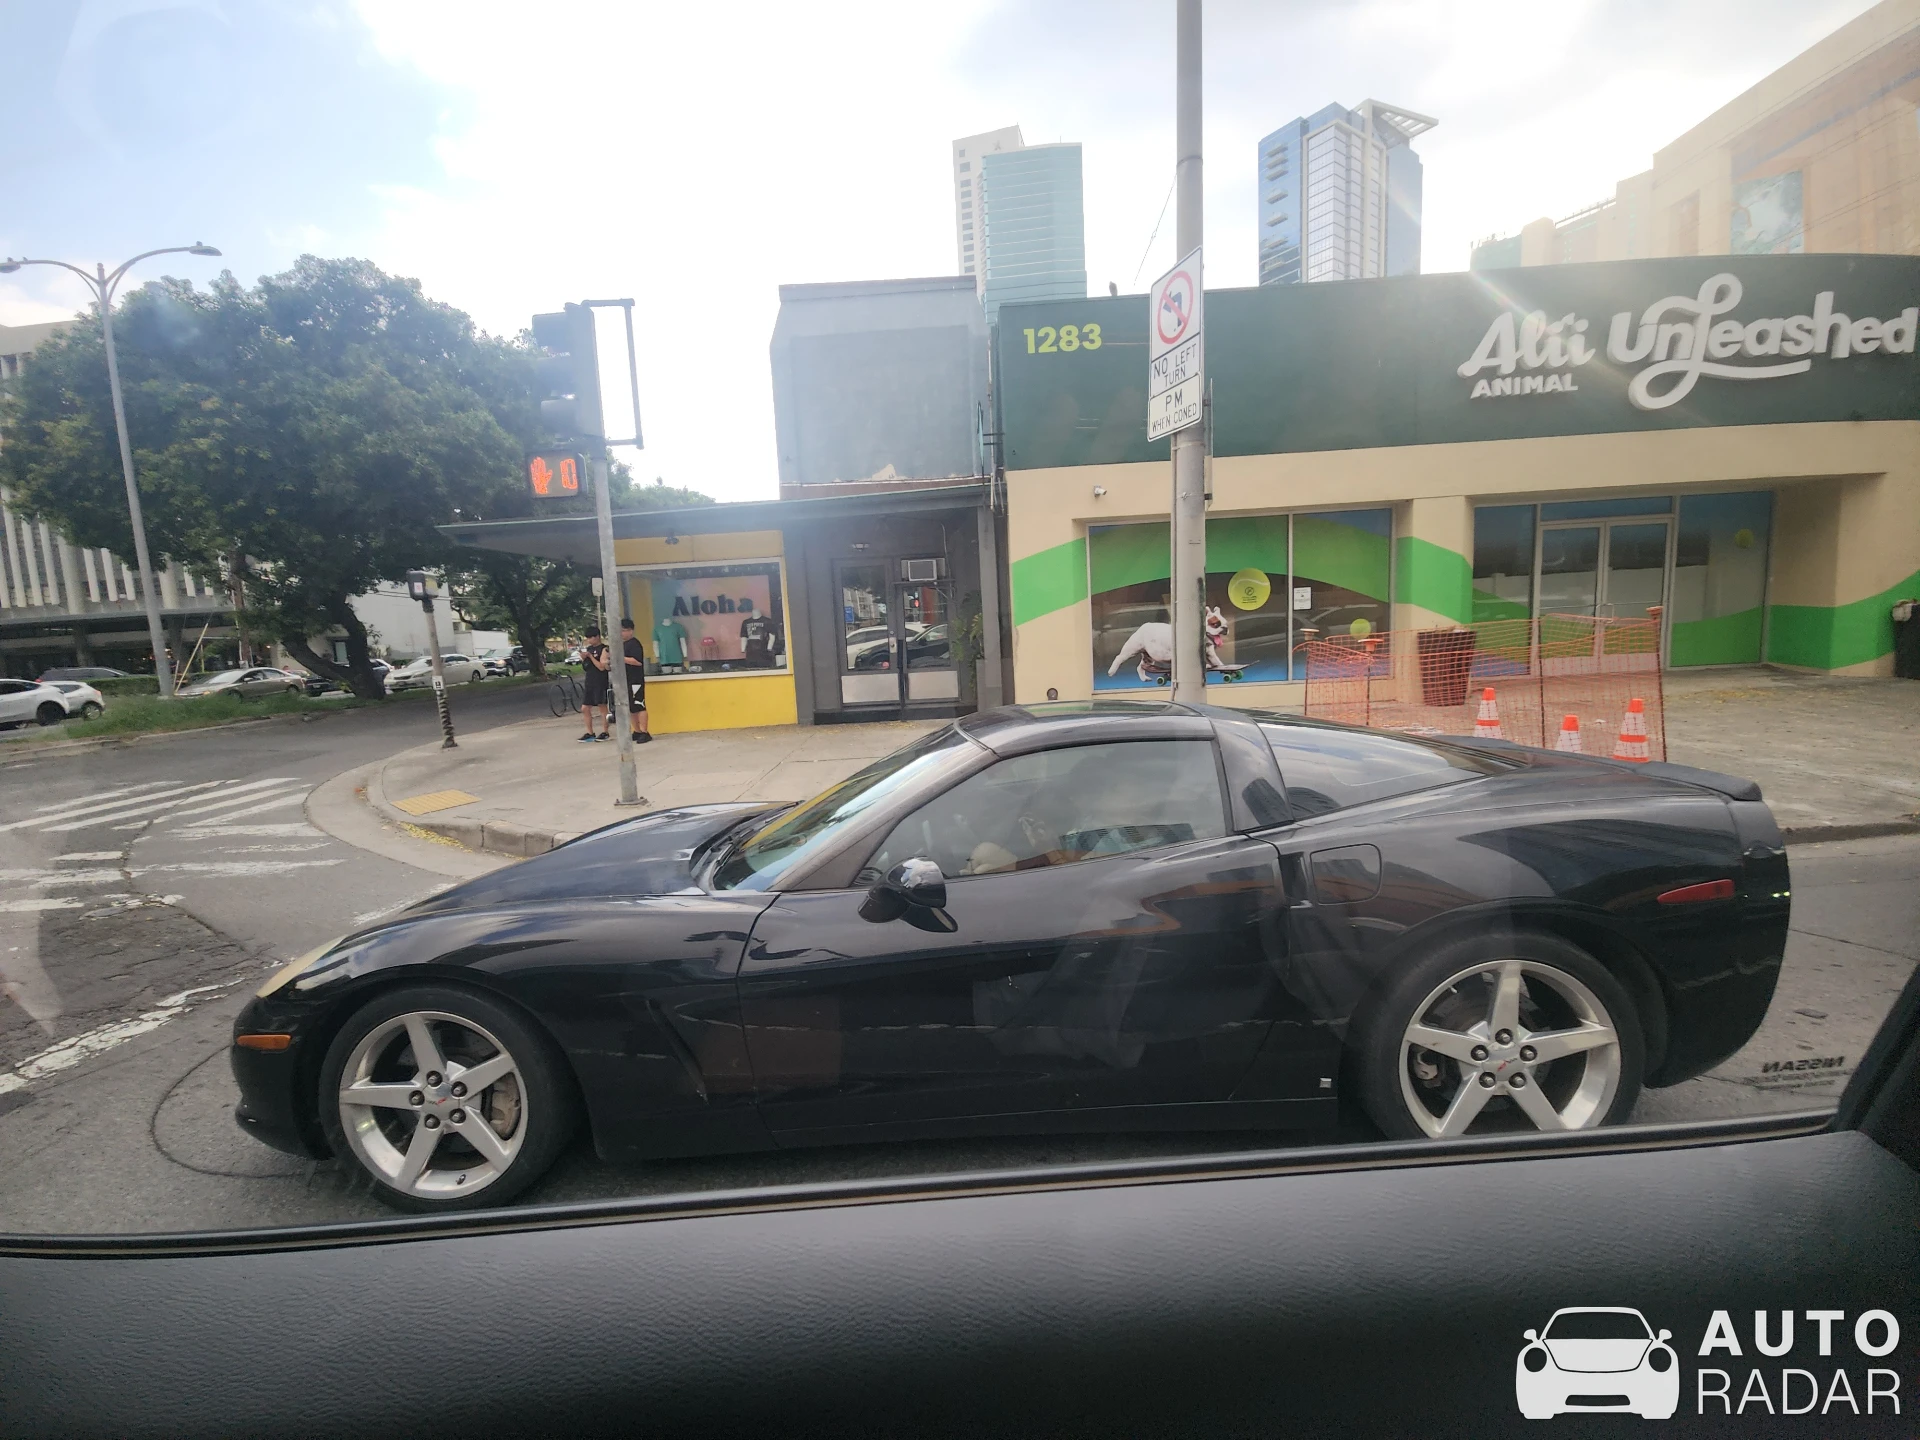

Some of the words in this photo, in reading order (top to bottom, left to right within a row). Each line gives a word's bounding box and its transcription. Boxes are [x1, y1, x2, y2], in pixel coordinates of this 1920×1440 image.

[1024, 323, 1102, 354] 1283
[1606, 273, 1919, 410] Unleashed
[1153, 357, 1168, 380] NO
[1175, 343, 1196, 368] LEFT
[1164, 365, 1186, 387] TURN
[1470, 373, 1579, 399] ANIMAL
[1152, 414, 1171, 433] WHEN
[1173, 402, 1197, 424] CONED
[672, 594, 753, 616] Aloha
